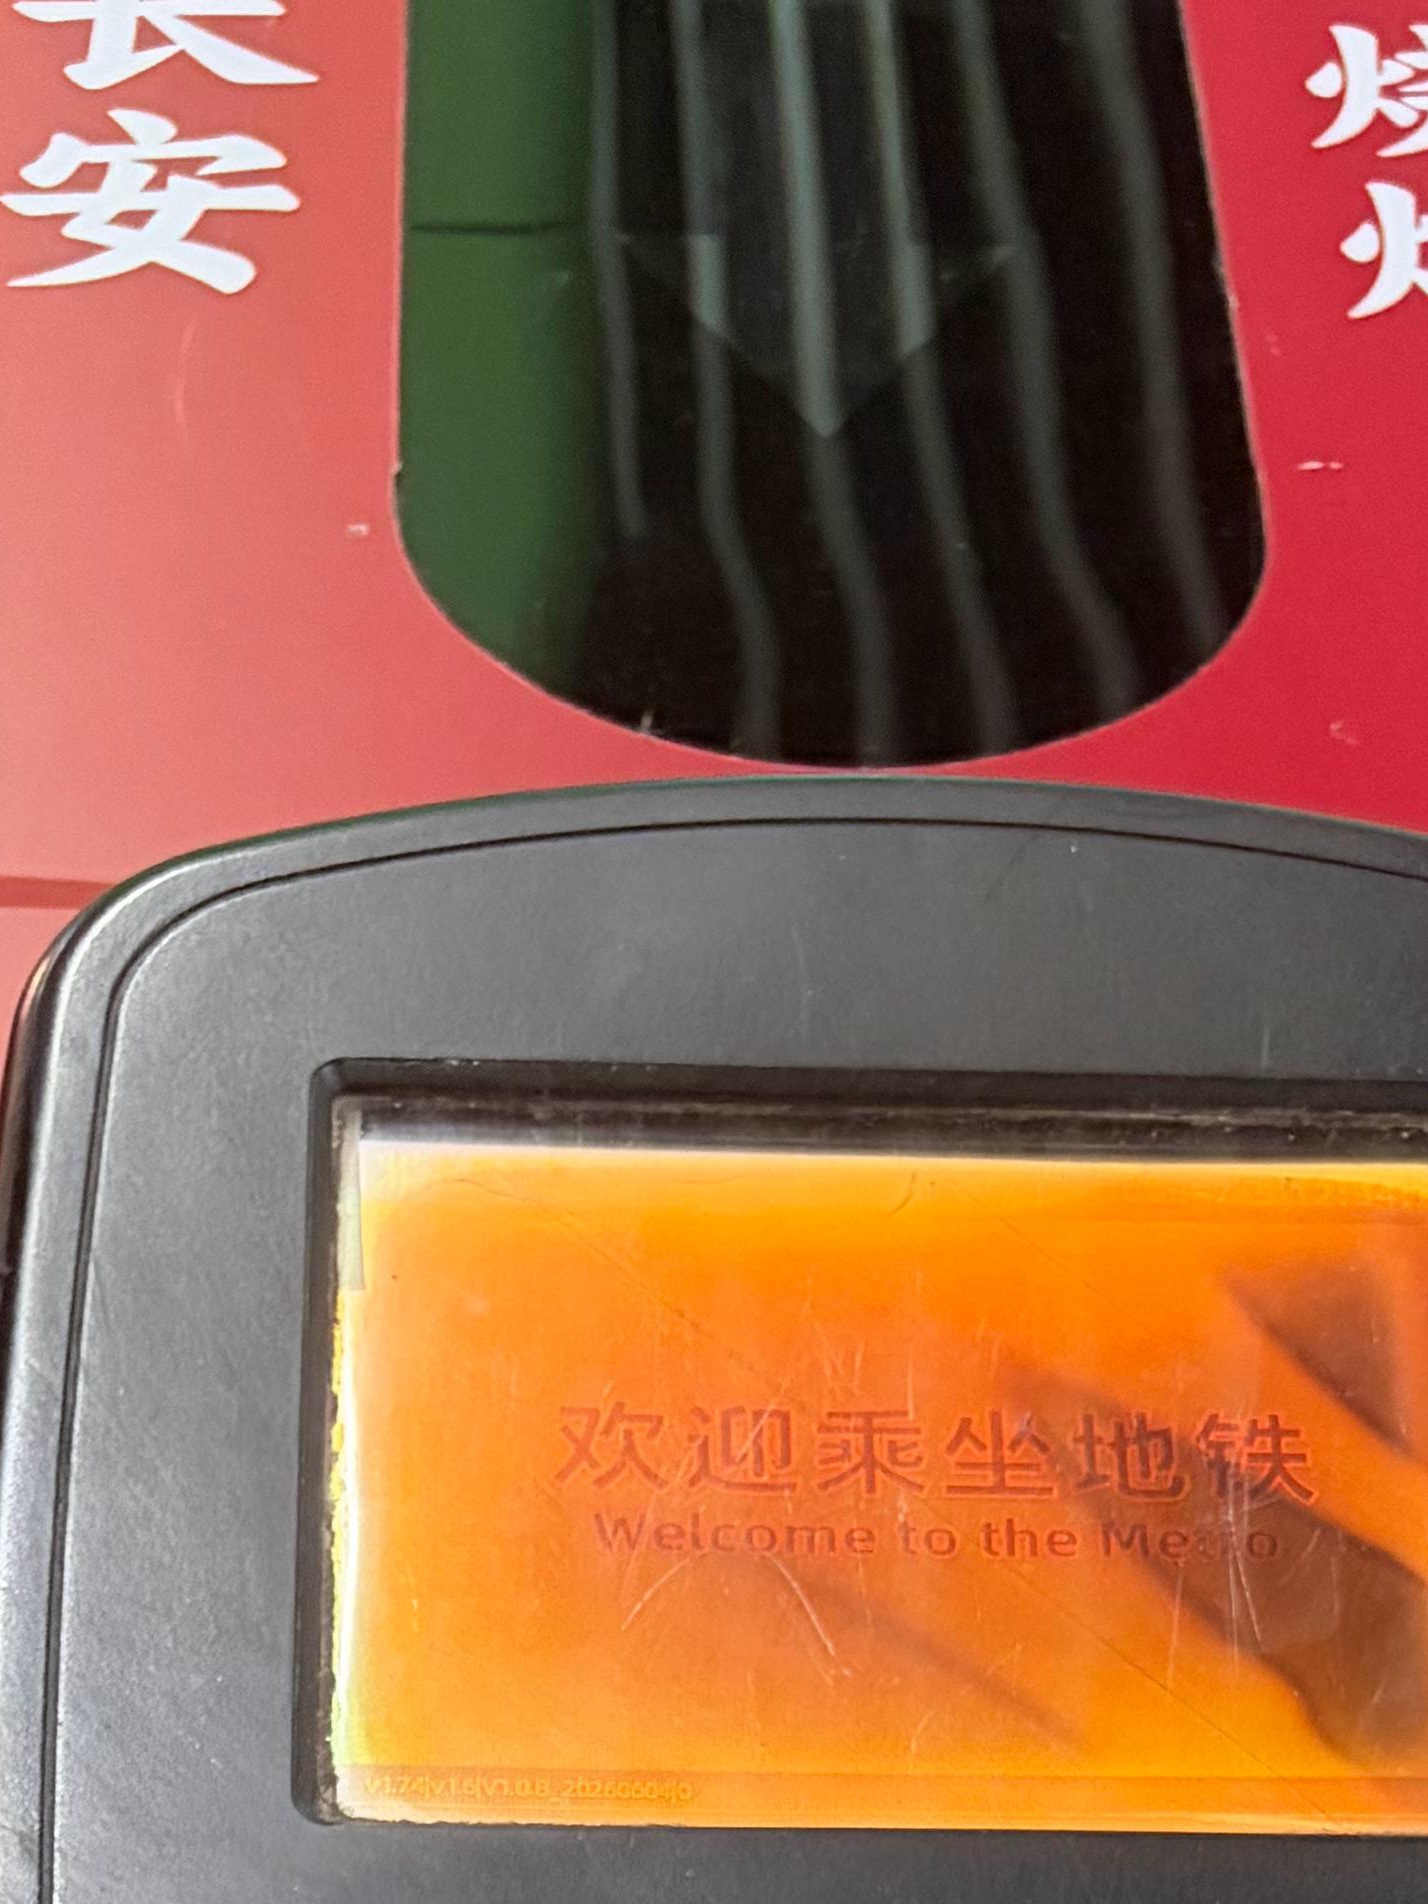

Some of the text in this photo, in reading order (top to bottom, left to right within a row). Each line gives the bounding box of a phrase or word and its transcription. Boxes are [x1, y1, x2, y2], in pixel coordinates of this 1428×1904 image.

[554, 1401, 1315, 1503] 欢迎乘坐地铁
[595, 1511, 877, 1556] Welcome
[898, 1516, 959, 1556] to
[982, 1517, 1079, 1558] the
